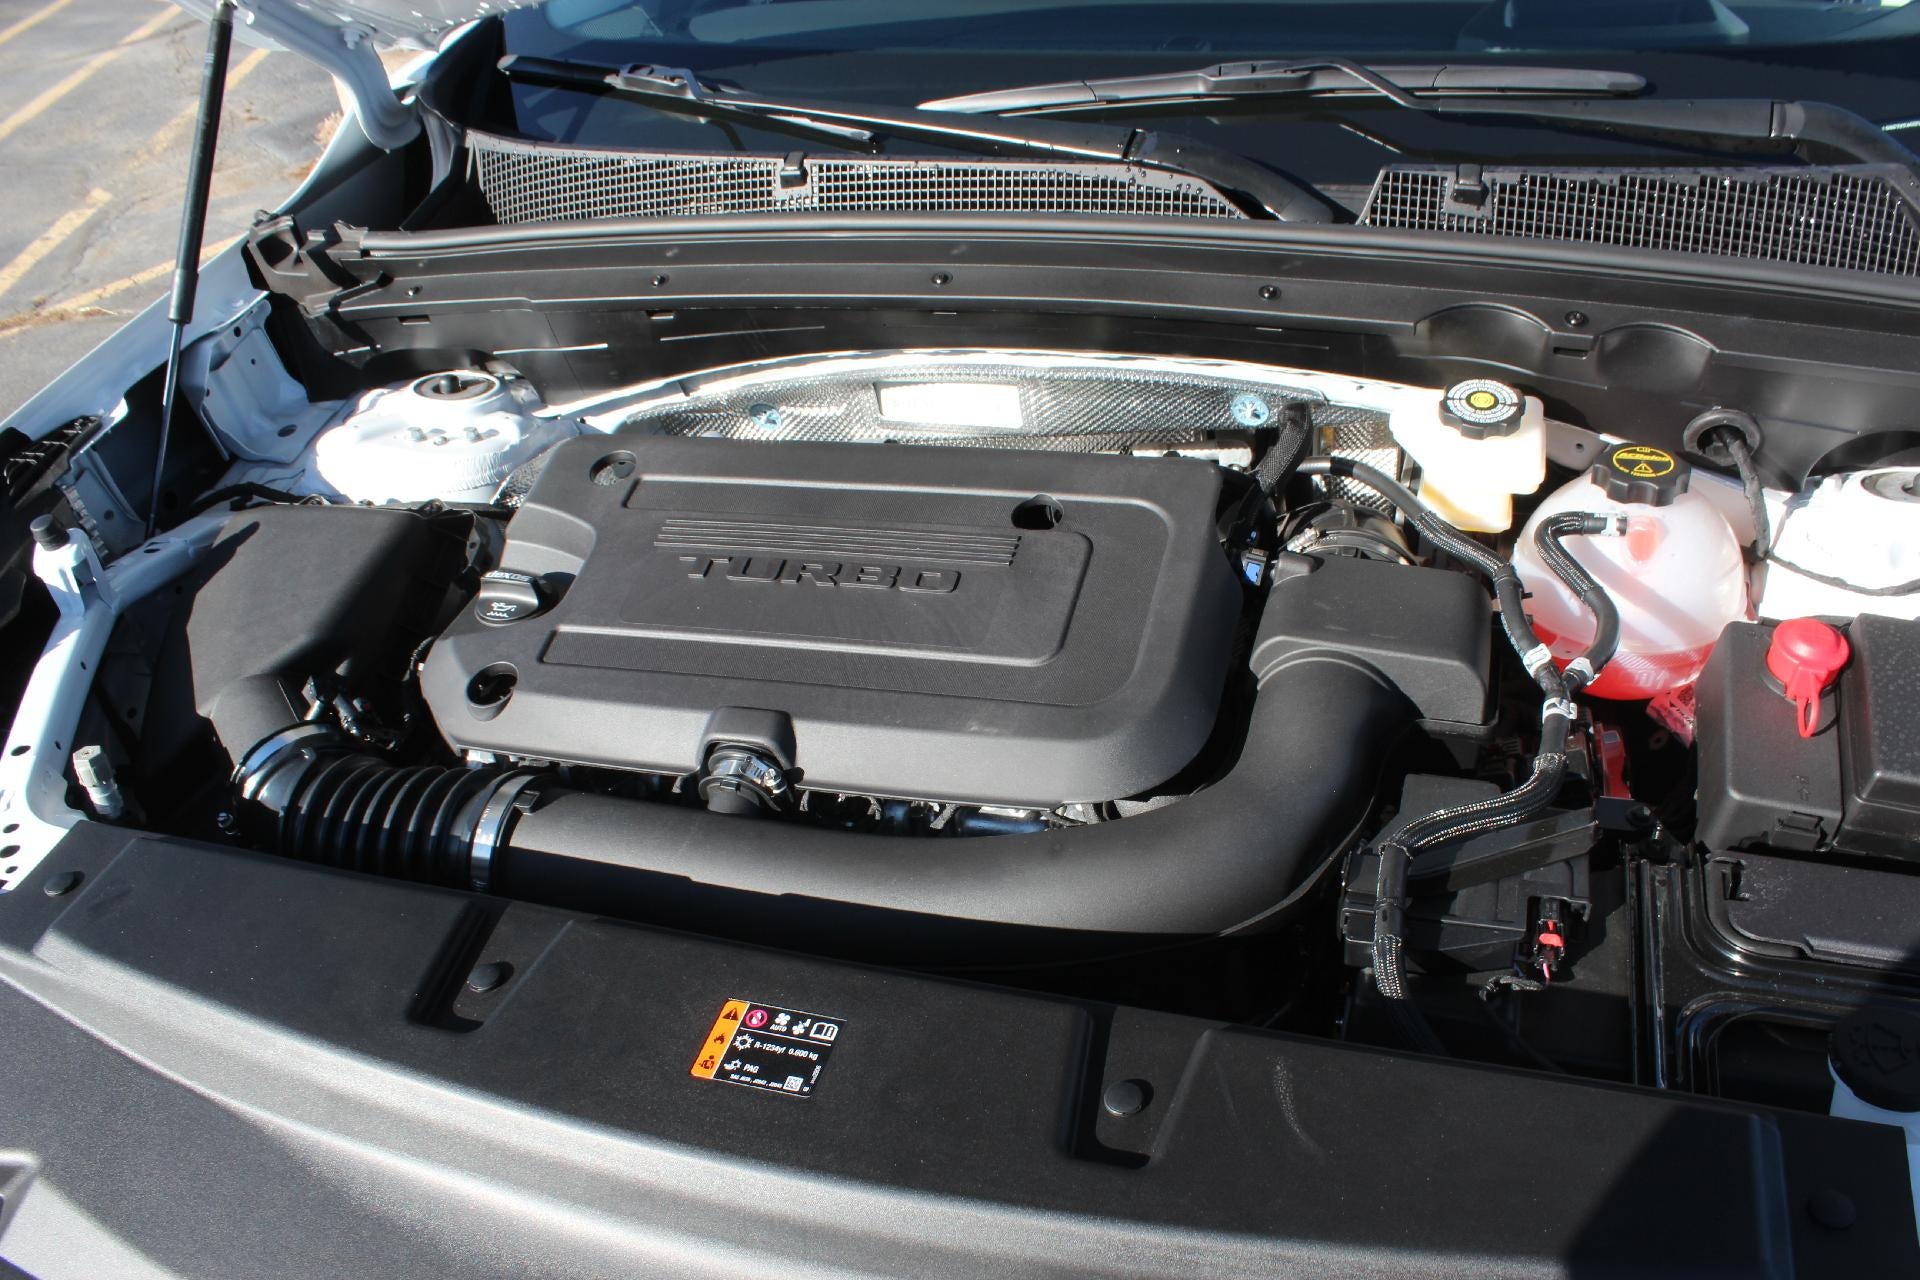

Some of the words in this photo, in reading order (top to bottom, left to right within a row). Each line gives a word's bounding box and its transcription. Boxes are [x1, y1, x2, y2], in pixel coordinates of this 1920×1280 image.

[485, 570, 533, 582] dexos
[679, 556, 962, 595] TURBO
[770, 1024, 787, 1032] AUTO
[754, 1041, 786, 1053] R-1234yf
[808, 1052, 819, 1061] kg
[743, 1063, 759, 1074] PAG
